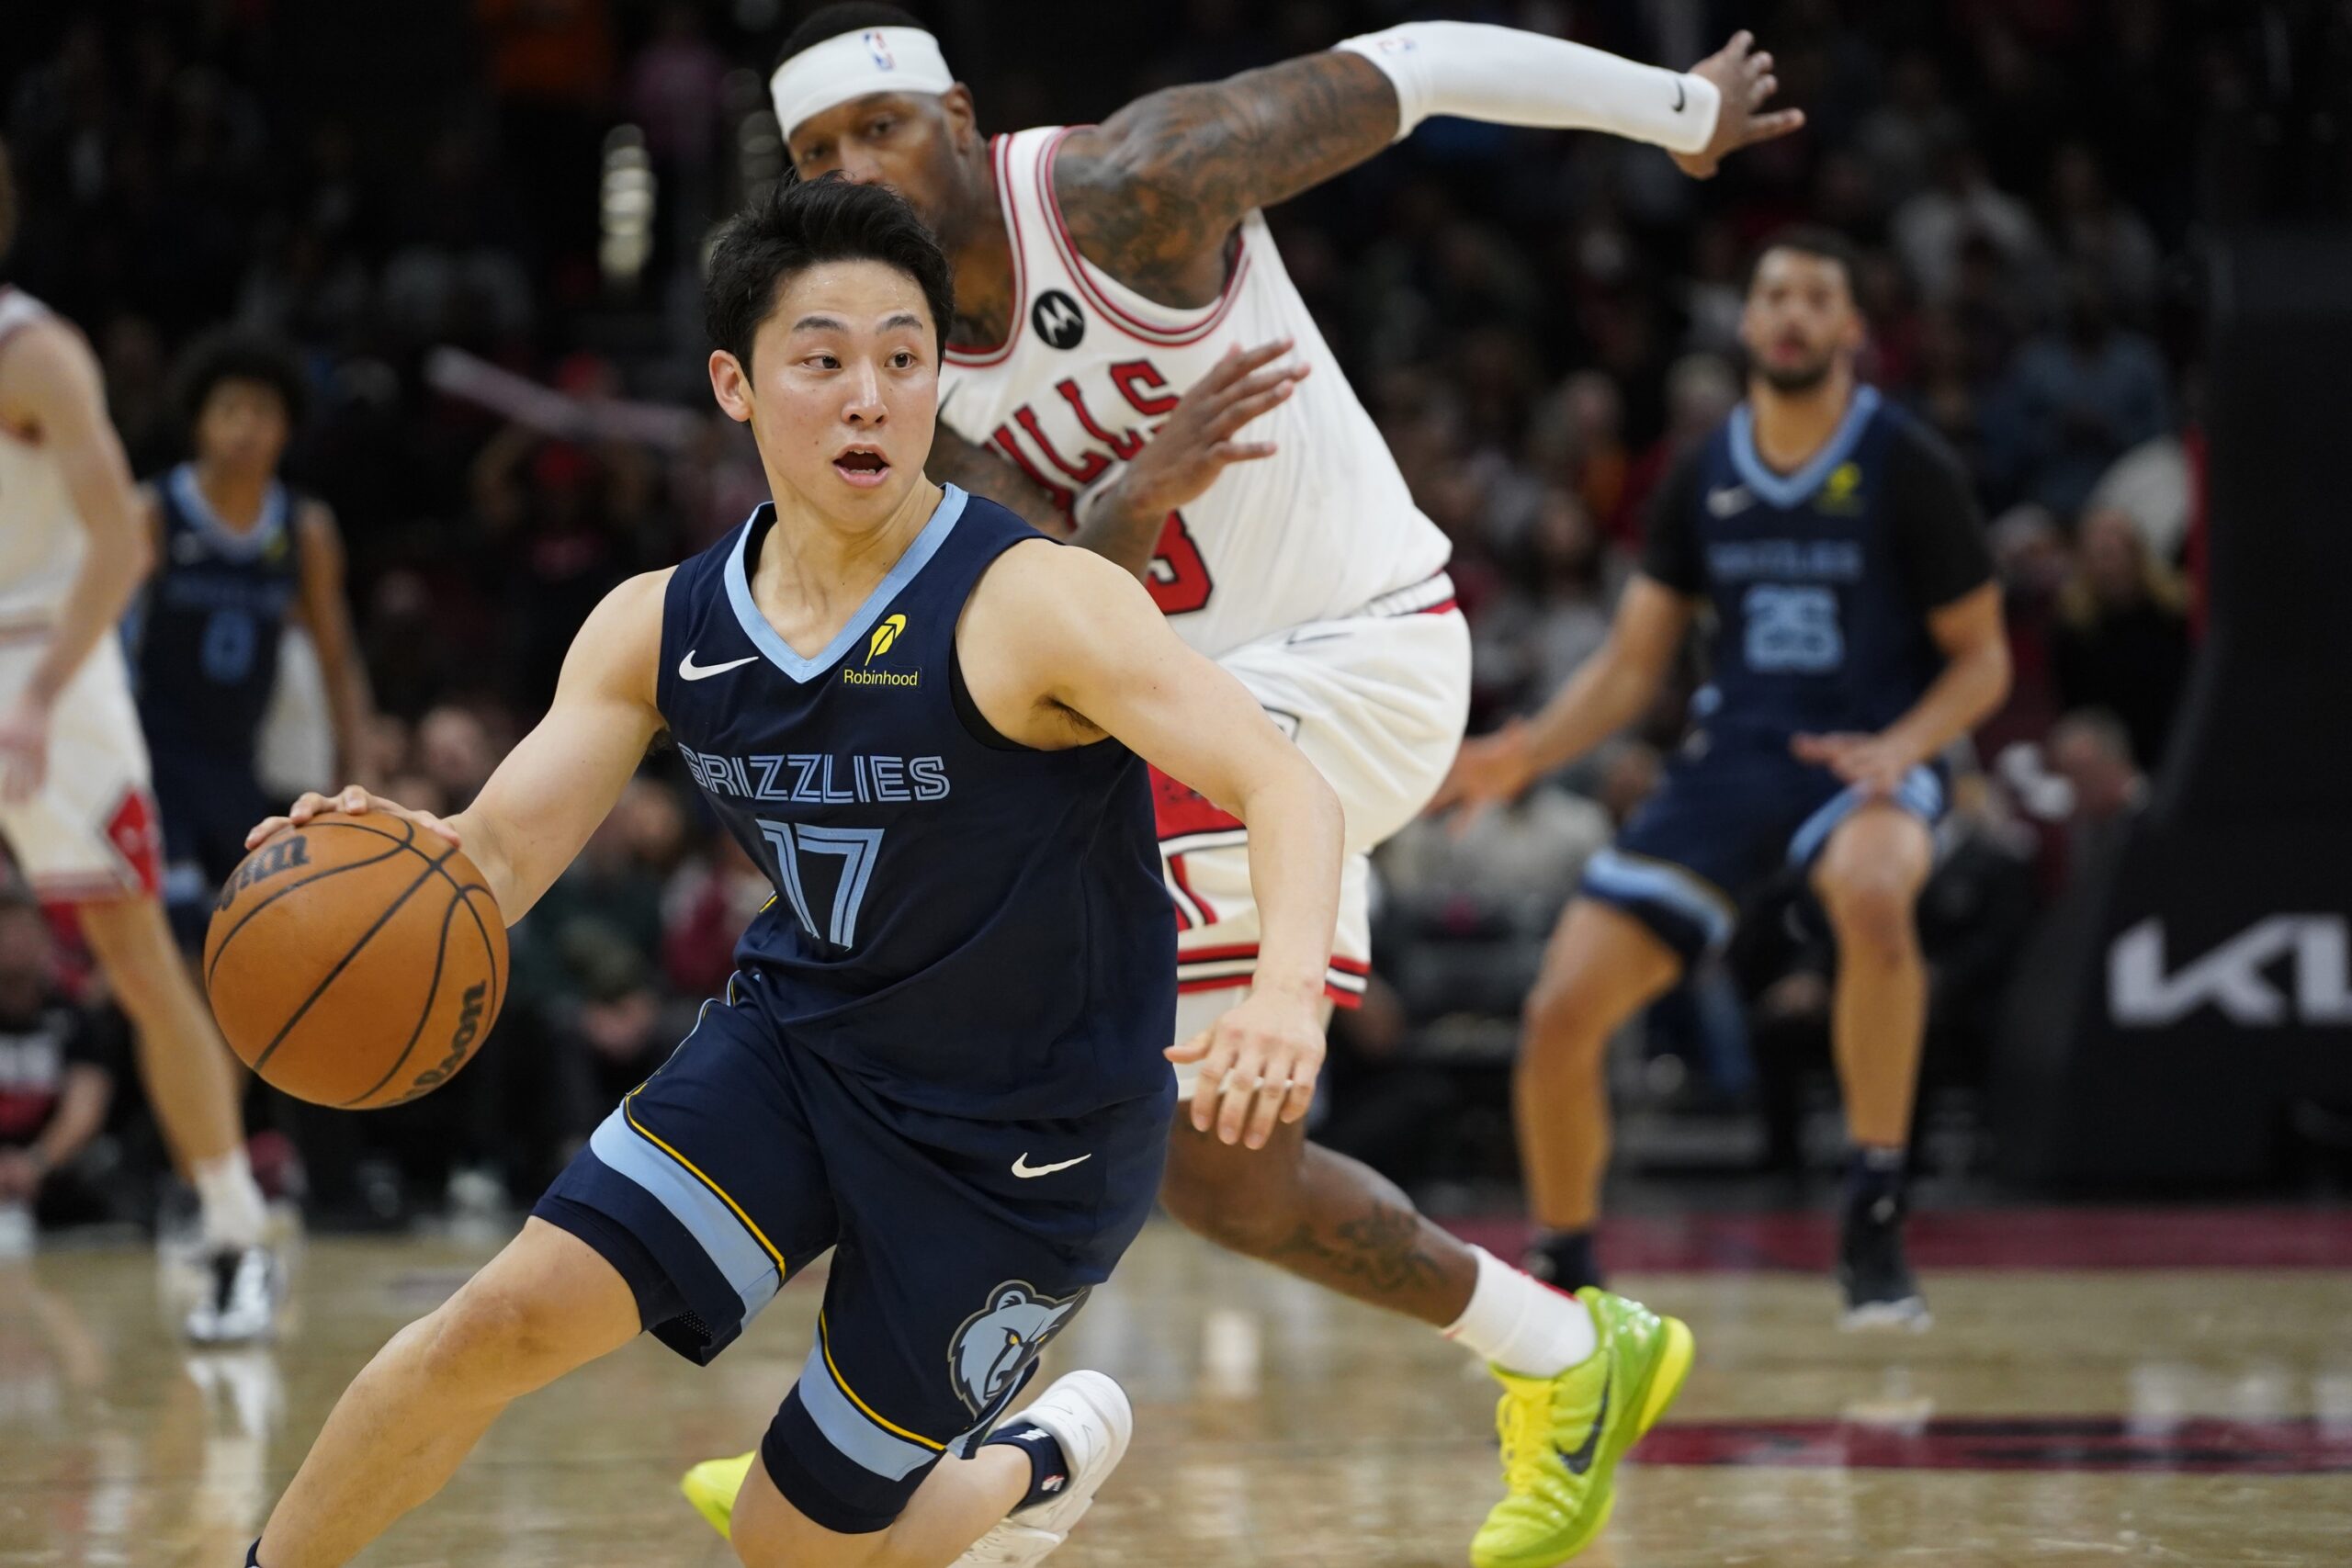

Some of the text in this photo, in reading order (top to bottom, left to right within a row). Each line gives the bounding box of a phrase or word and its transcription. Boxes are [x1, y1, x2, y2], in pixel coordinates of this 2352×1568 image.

[843, 669, 918, 686] Robinhood
[677, 741, 951, 804] GRIZZLIES
[755, 818, 885, 952] 17
[2109, 915, 2352, 1026] KI
